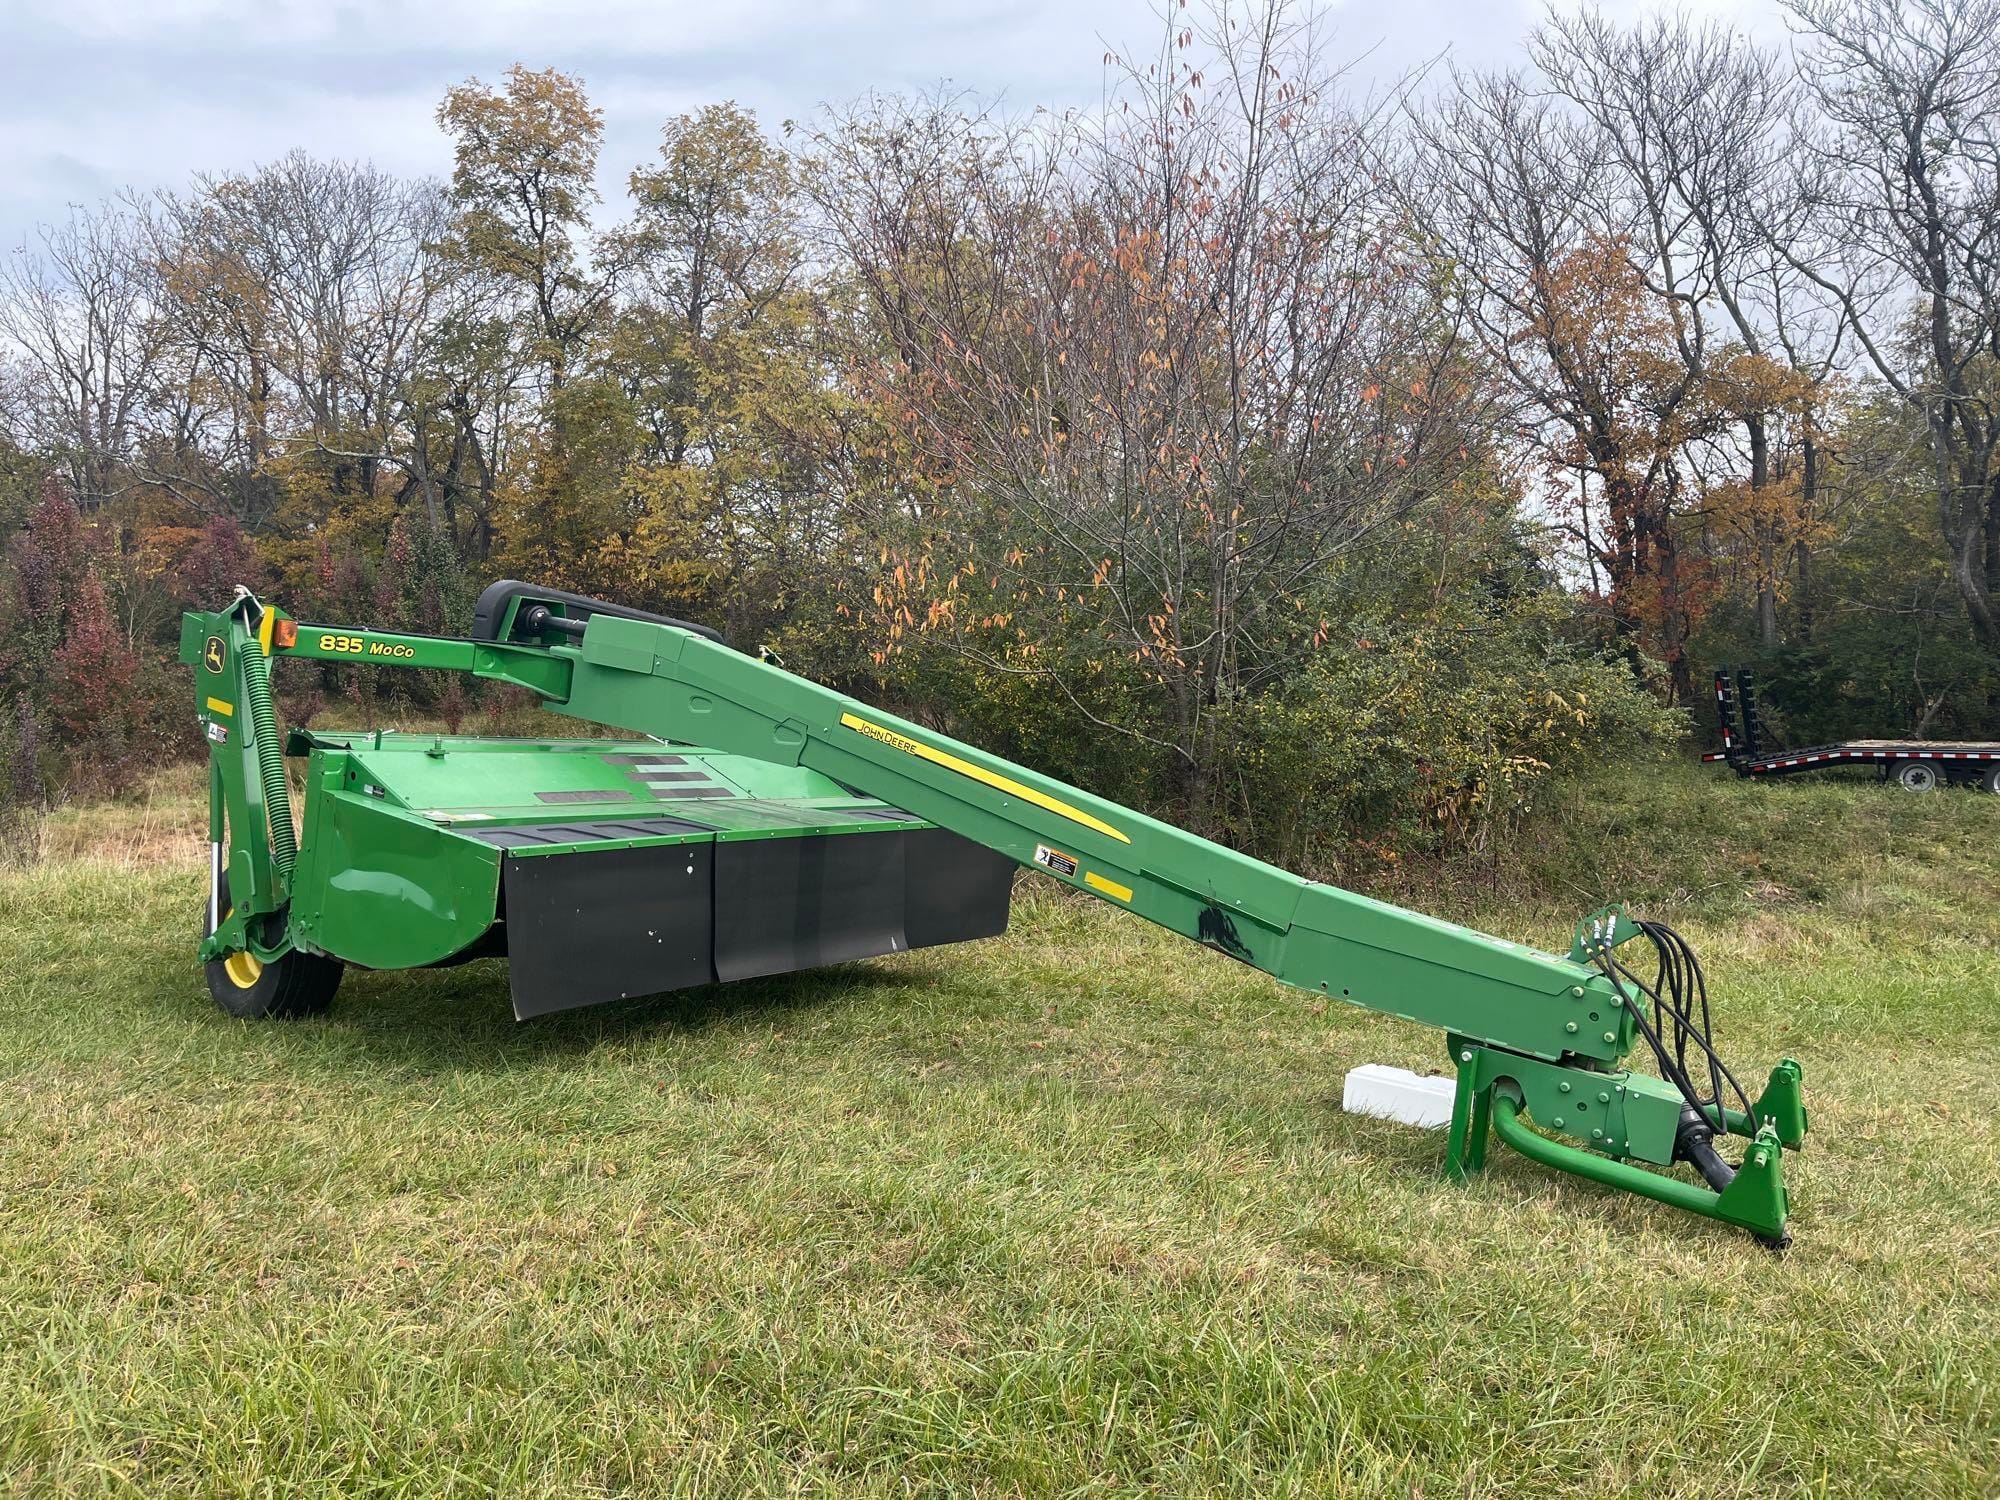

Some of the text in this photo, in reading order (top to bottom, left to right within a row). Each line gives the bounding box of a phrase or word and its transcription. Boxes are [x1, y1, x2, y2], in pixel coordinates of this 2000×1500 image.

[319, 634, 415, 658] 835 MoCo
[858, 723, 917, 754] JOHN DEERE
